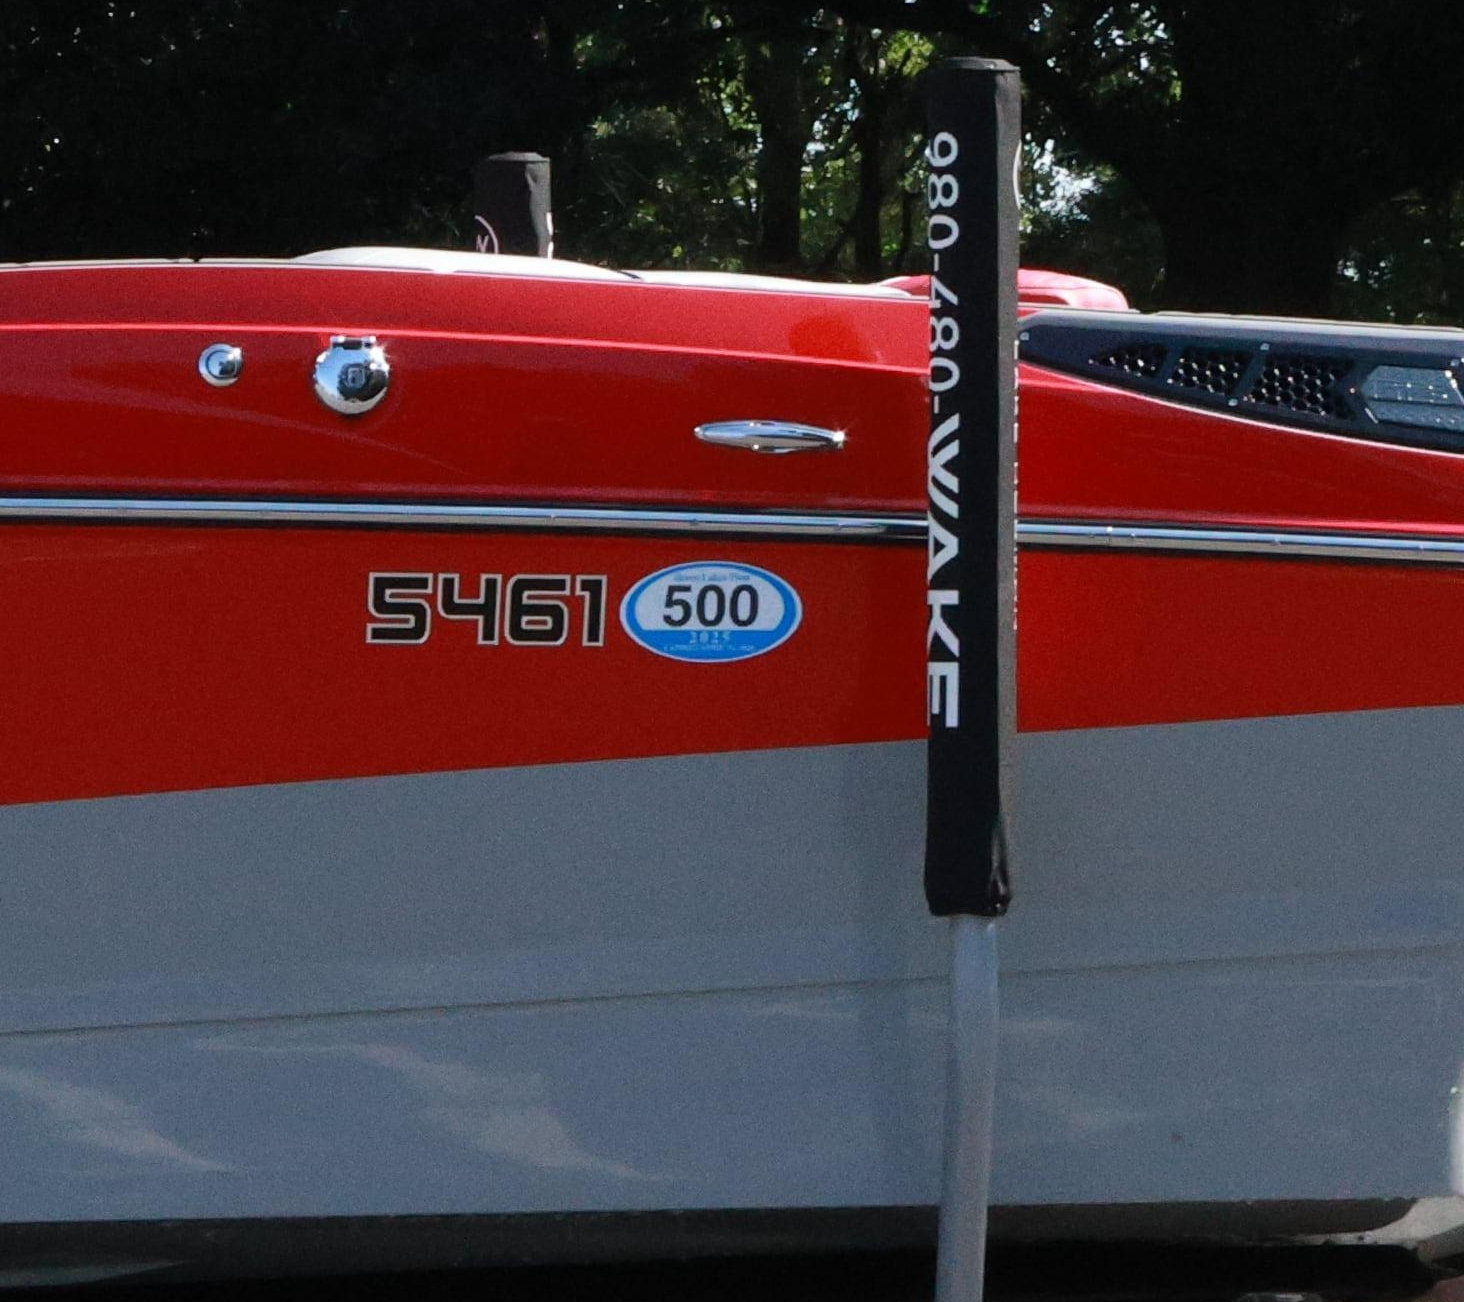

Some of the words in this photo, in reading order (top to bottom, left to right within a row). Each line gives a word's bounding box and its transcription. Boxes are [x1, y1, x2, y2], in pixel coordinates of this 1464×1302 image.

[925, 131, 960, 728] 980-480-WAKE
[366, 571, 607, 647] 5461
[663, 584, 759, 627] 500
